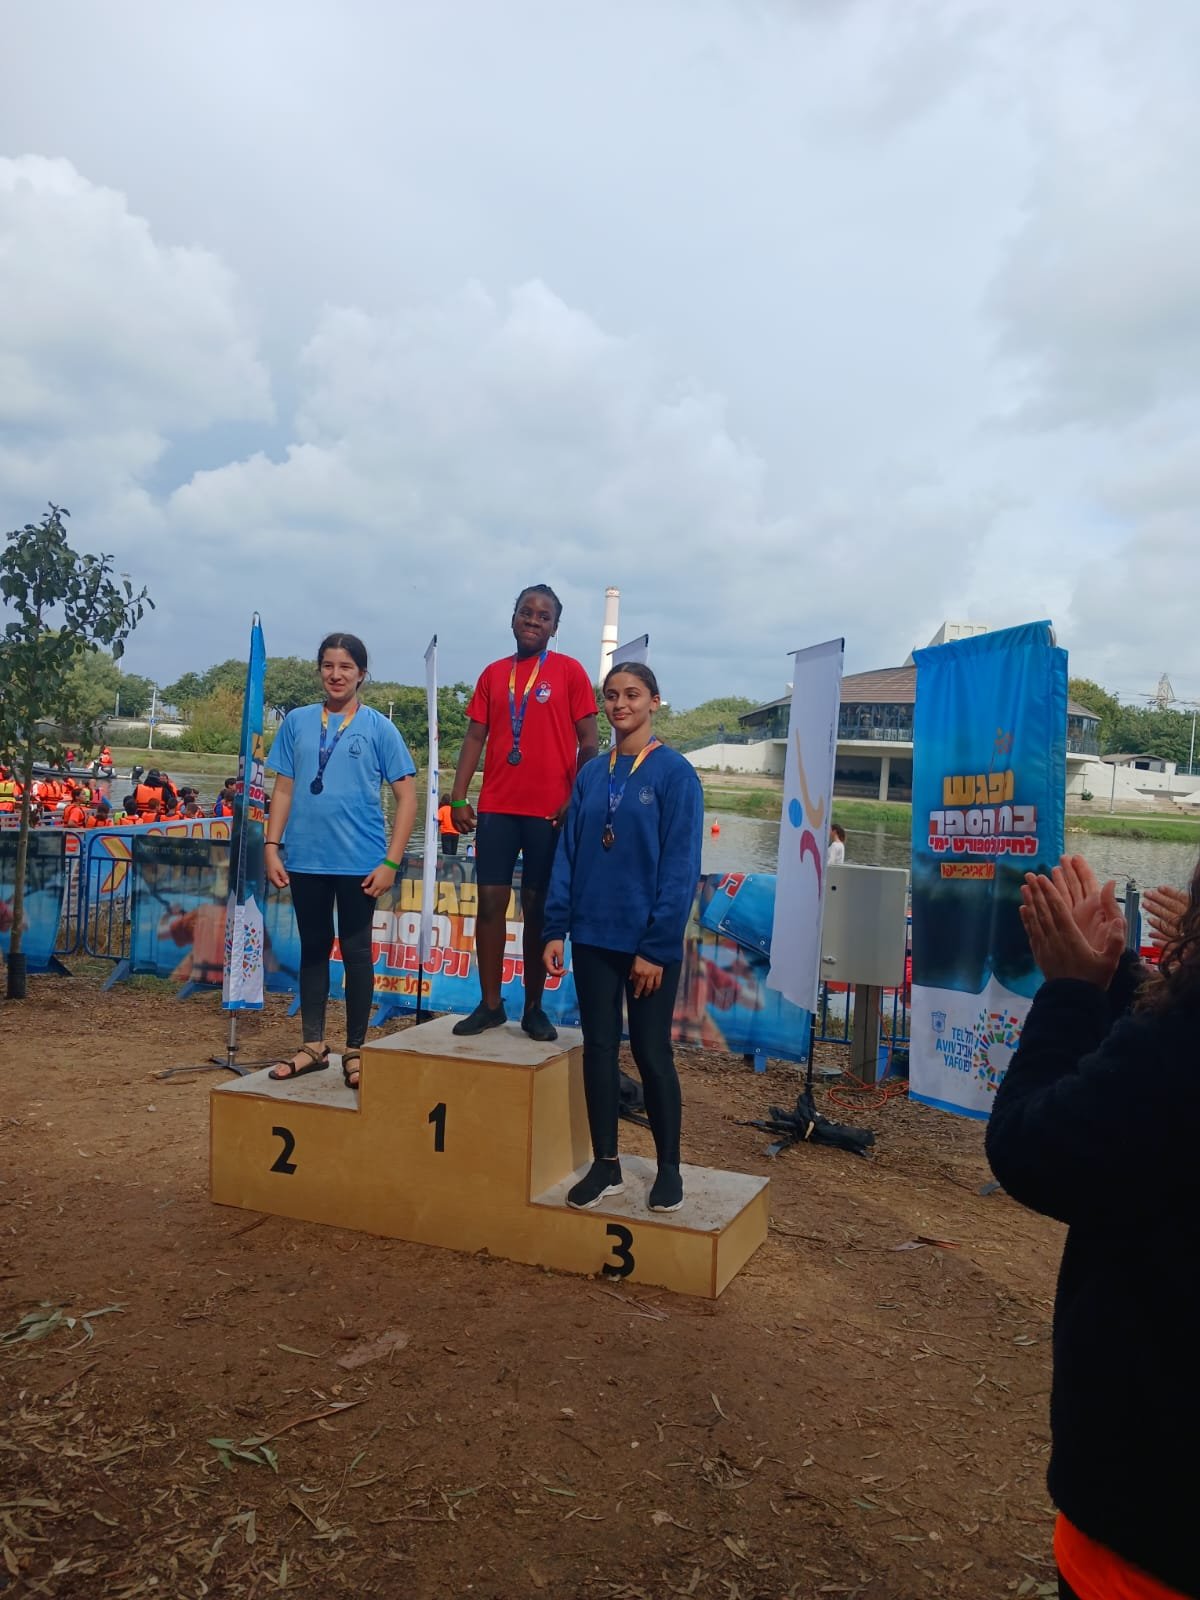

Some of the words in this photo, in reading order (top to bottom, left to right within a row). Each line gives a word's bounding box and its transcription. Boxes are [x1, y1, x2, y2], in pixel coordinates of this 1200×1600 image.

[929, 808, 997, 836] הספר
[936, 1038, 956, 1053] AVIV
[952, 1027, 965, 1042] TEL
[944, 1055, 963, 1070] YAFO
[428, 1103, 448, 1152] 1
[269, 1126, 298, 1175] 2
[603, 1223, 635, 1279] 3
